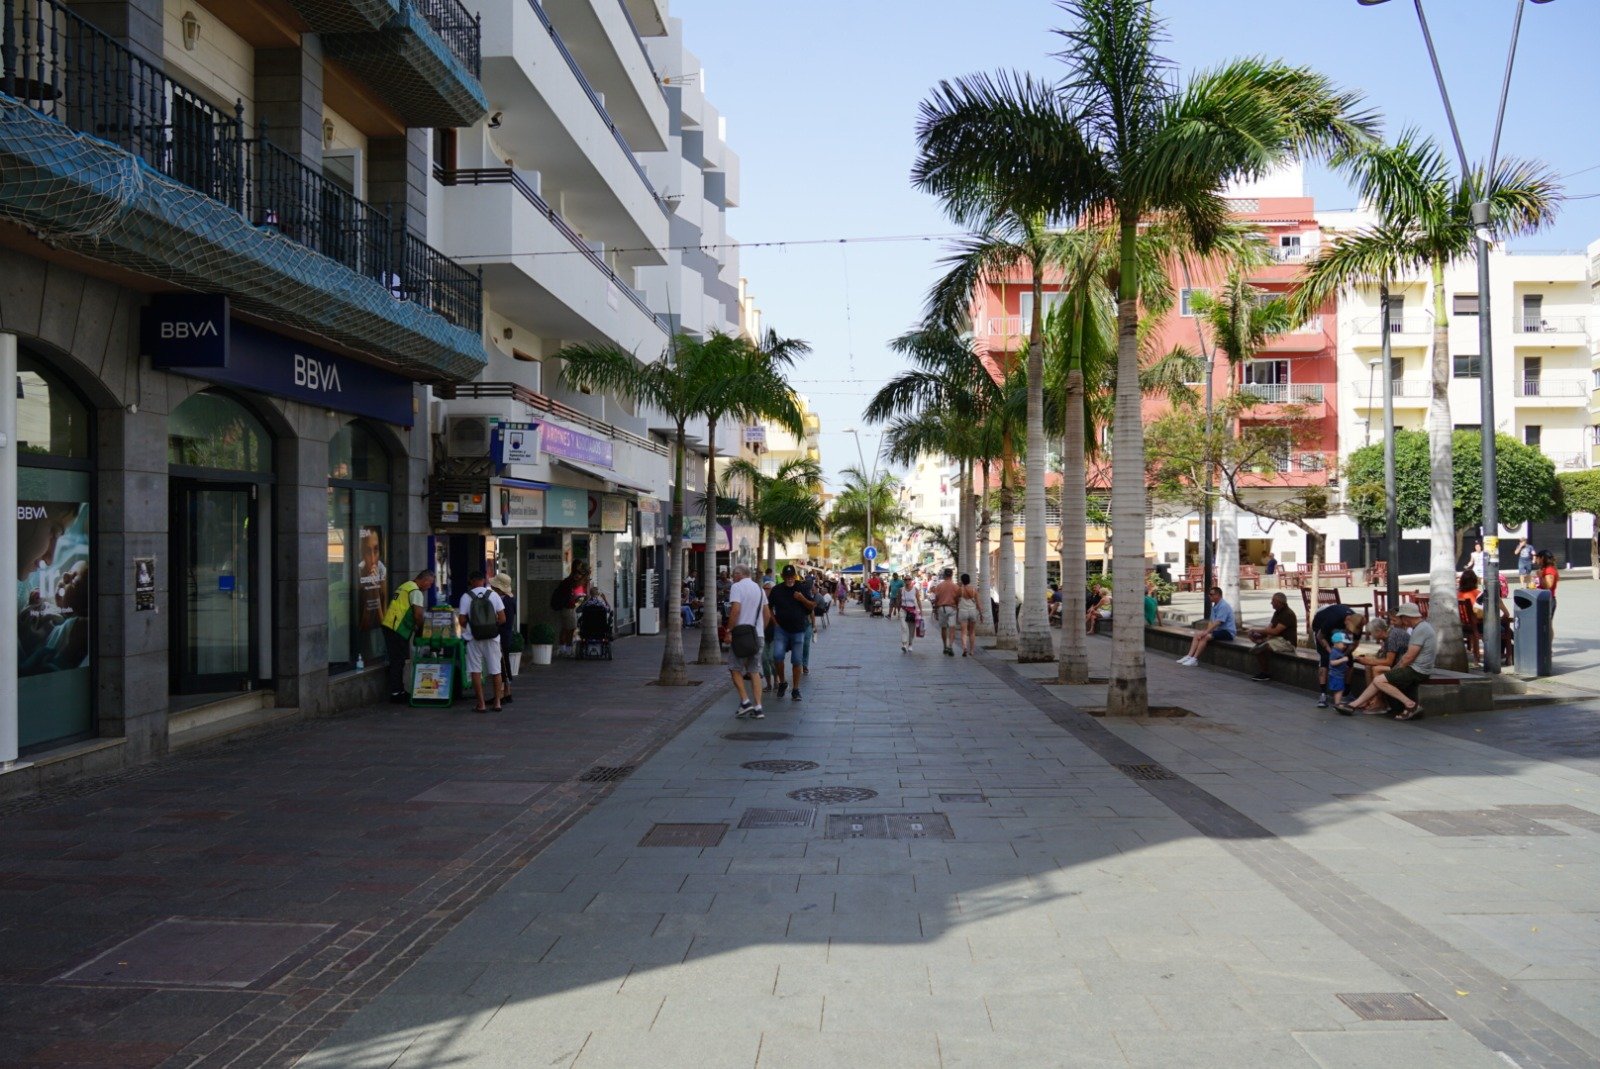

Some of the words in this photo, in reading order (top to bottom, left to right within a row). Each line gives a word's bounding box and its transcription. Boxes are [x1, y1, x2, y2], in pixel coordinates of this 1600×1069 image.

[161, 321, 218, 338] BBVA
[294, 354, 342, 392] BBVA
[17, 506, 48, 520] BBVA
